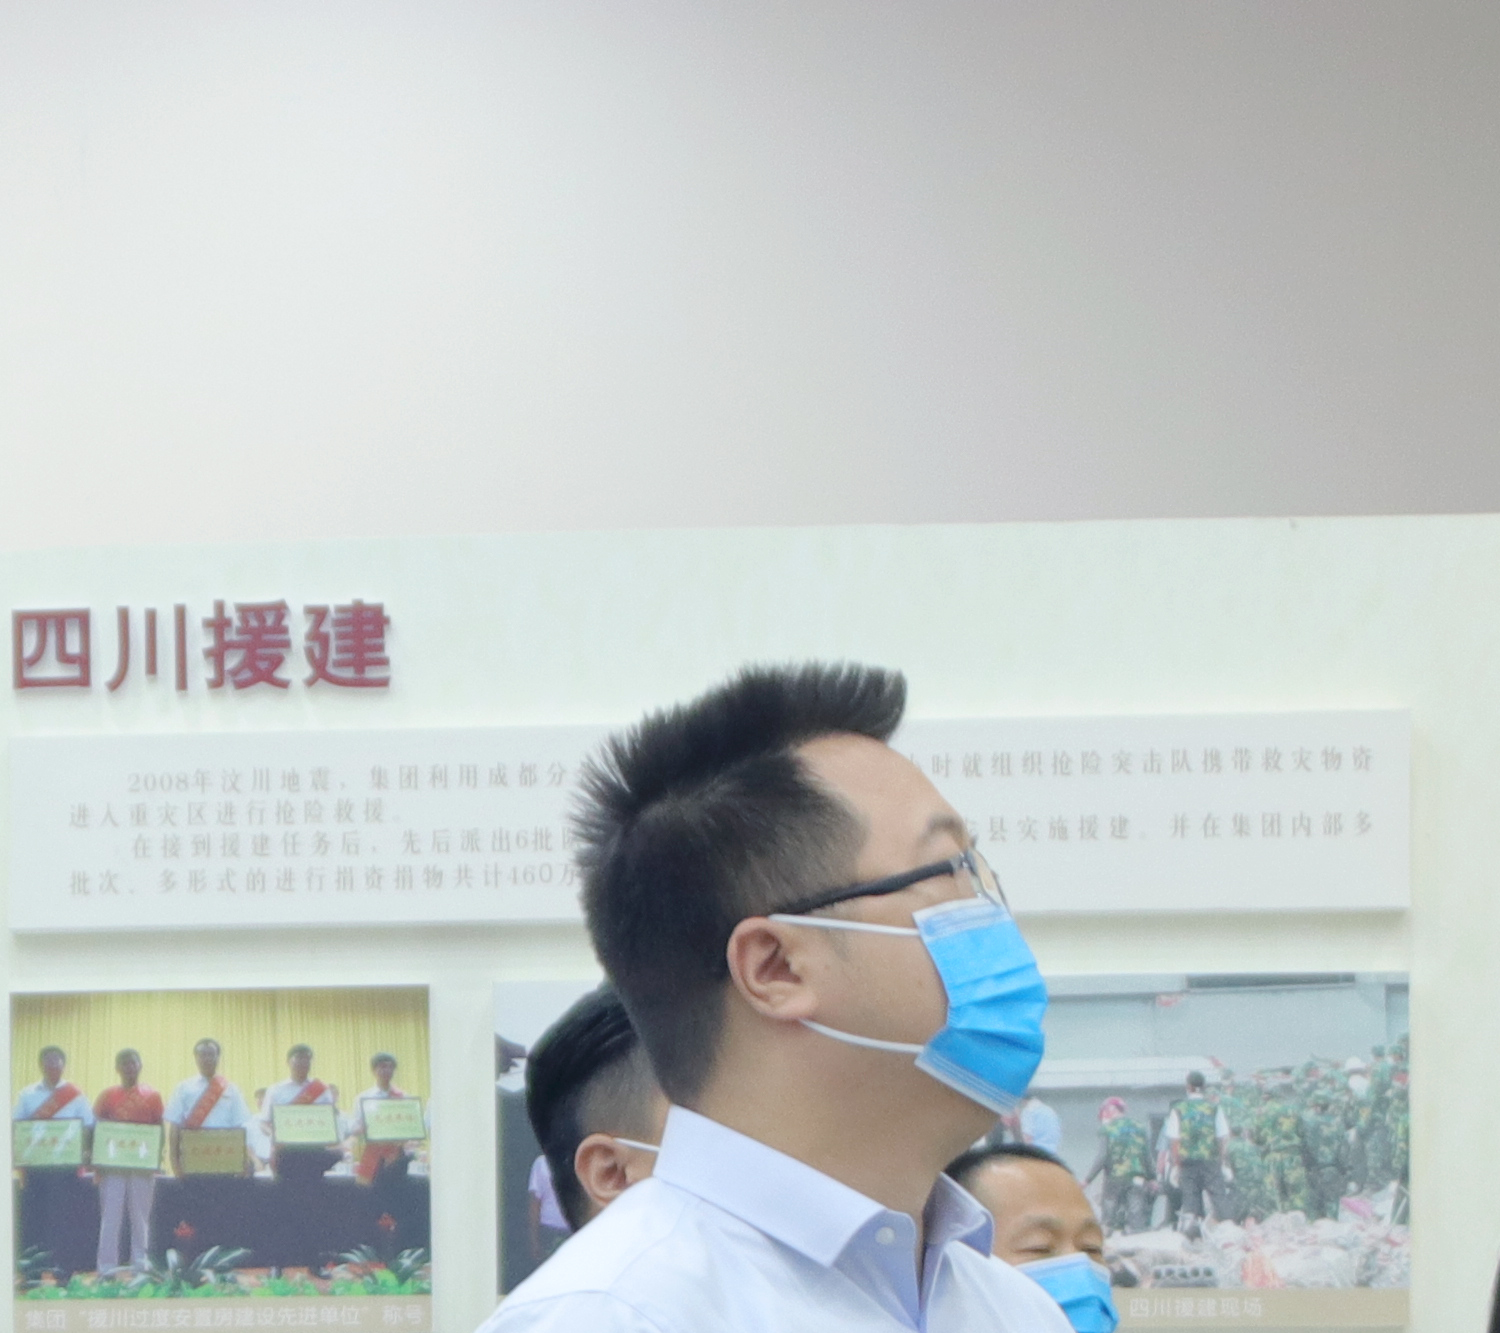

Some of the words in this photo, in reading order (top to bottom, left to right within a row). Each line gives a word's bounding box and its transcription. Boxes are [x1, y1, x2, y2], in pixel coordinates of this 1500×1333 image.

[11, 599, 392, 692] 四川援建
[126, 764, 580, 796] 2008年汶川地震，集团利用成都分
[911, 745, 1374, 779] 时就组织抢险突击队携带救灾物资
[68, 798, 401, 830] 进入重灾区进行抢险救援。
[1128, 1296, 1264, 1318] 四川援建现场
